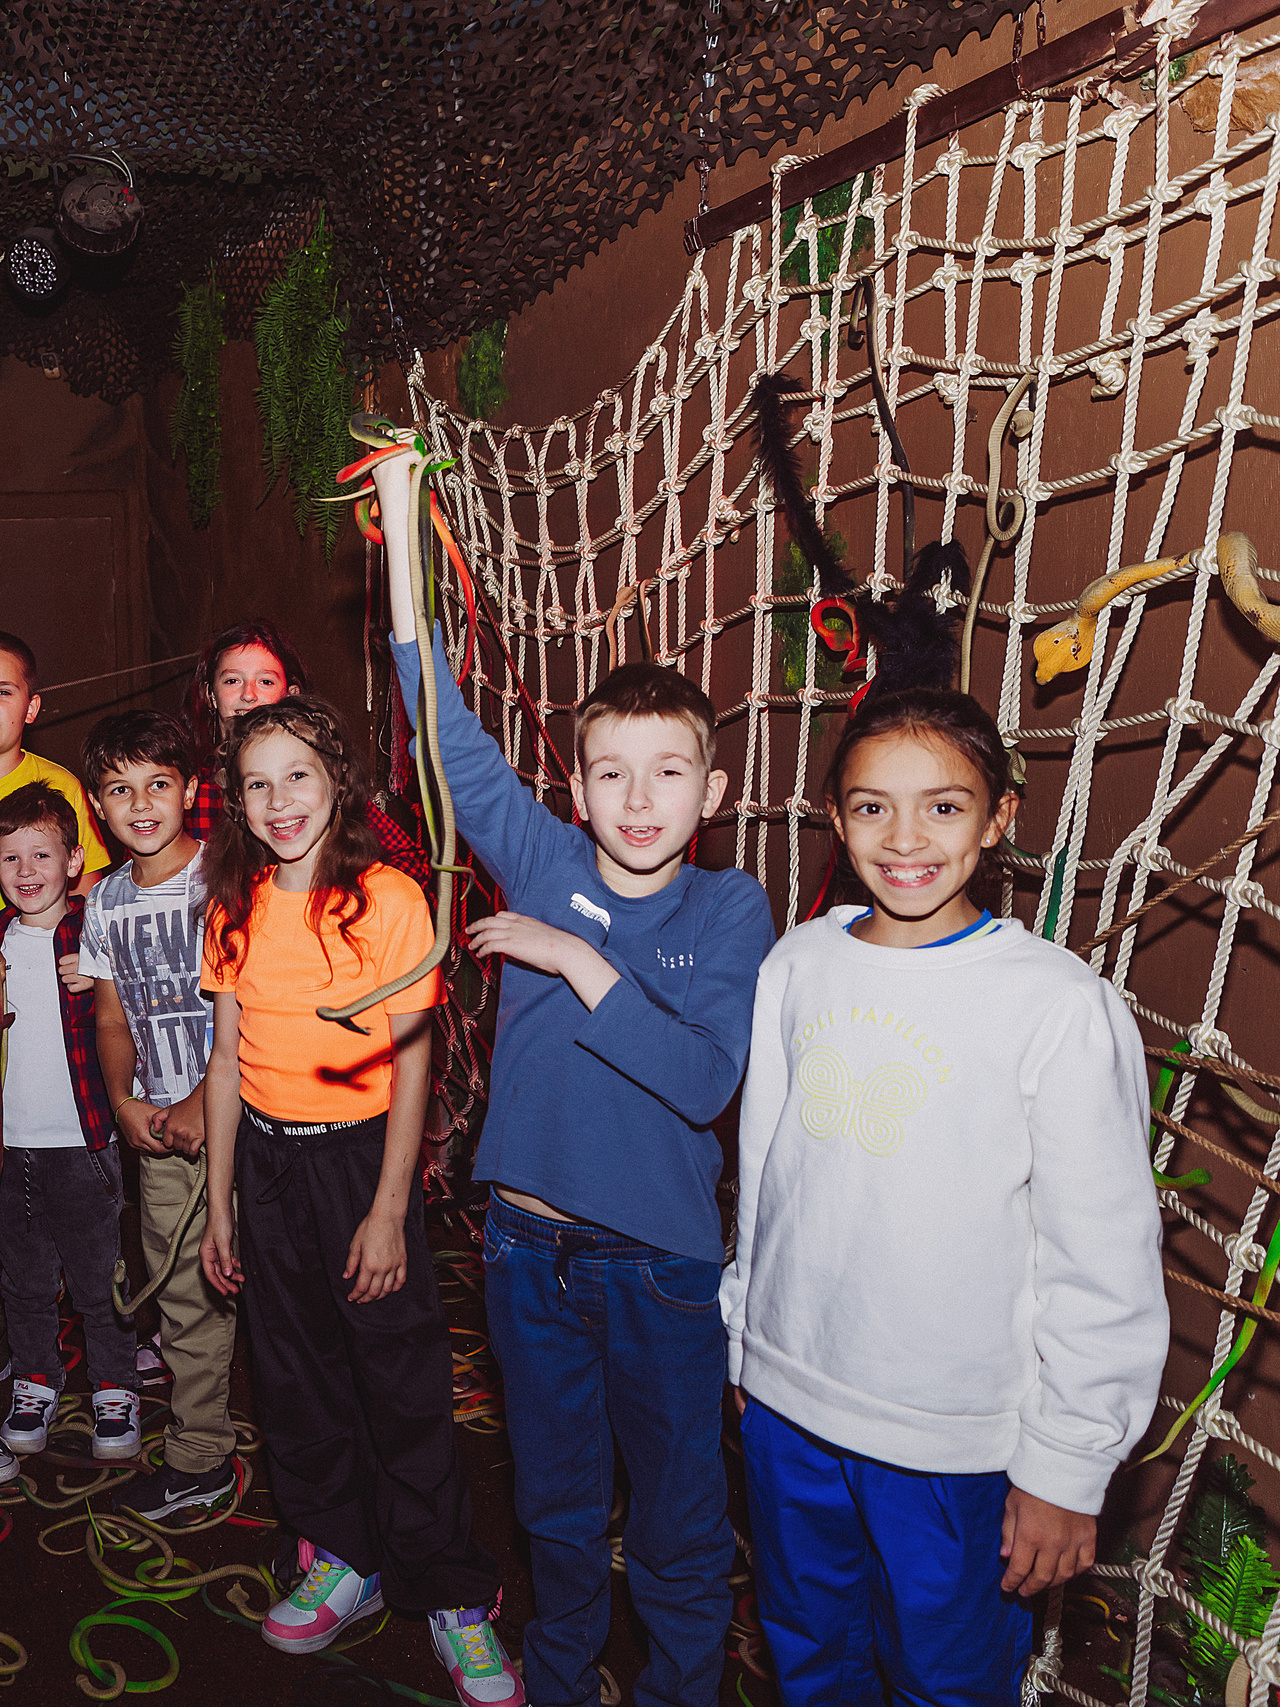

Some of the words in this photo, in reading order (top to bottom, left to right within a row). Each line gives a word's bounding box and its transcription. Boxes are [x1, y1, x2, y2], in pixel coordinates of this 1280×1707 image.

[109, 908, 200, 981] NEW
[123, 976, 207, 1016] YORK
[794, 1011, 834, 1051] JOLI
[851, 1007, 955, 1083] PAPILLON
[282, 1123, 328, 1137] WARNING
